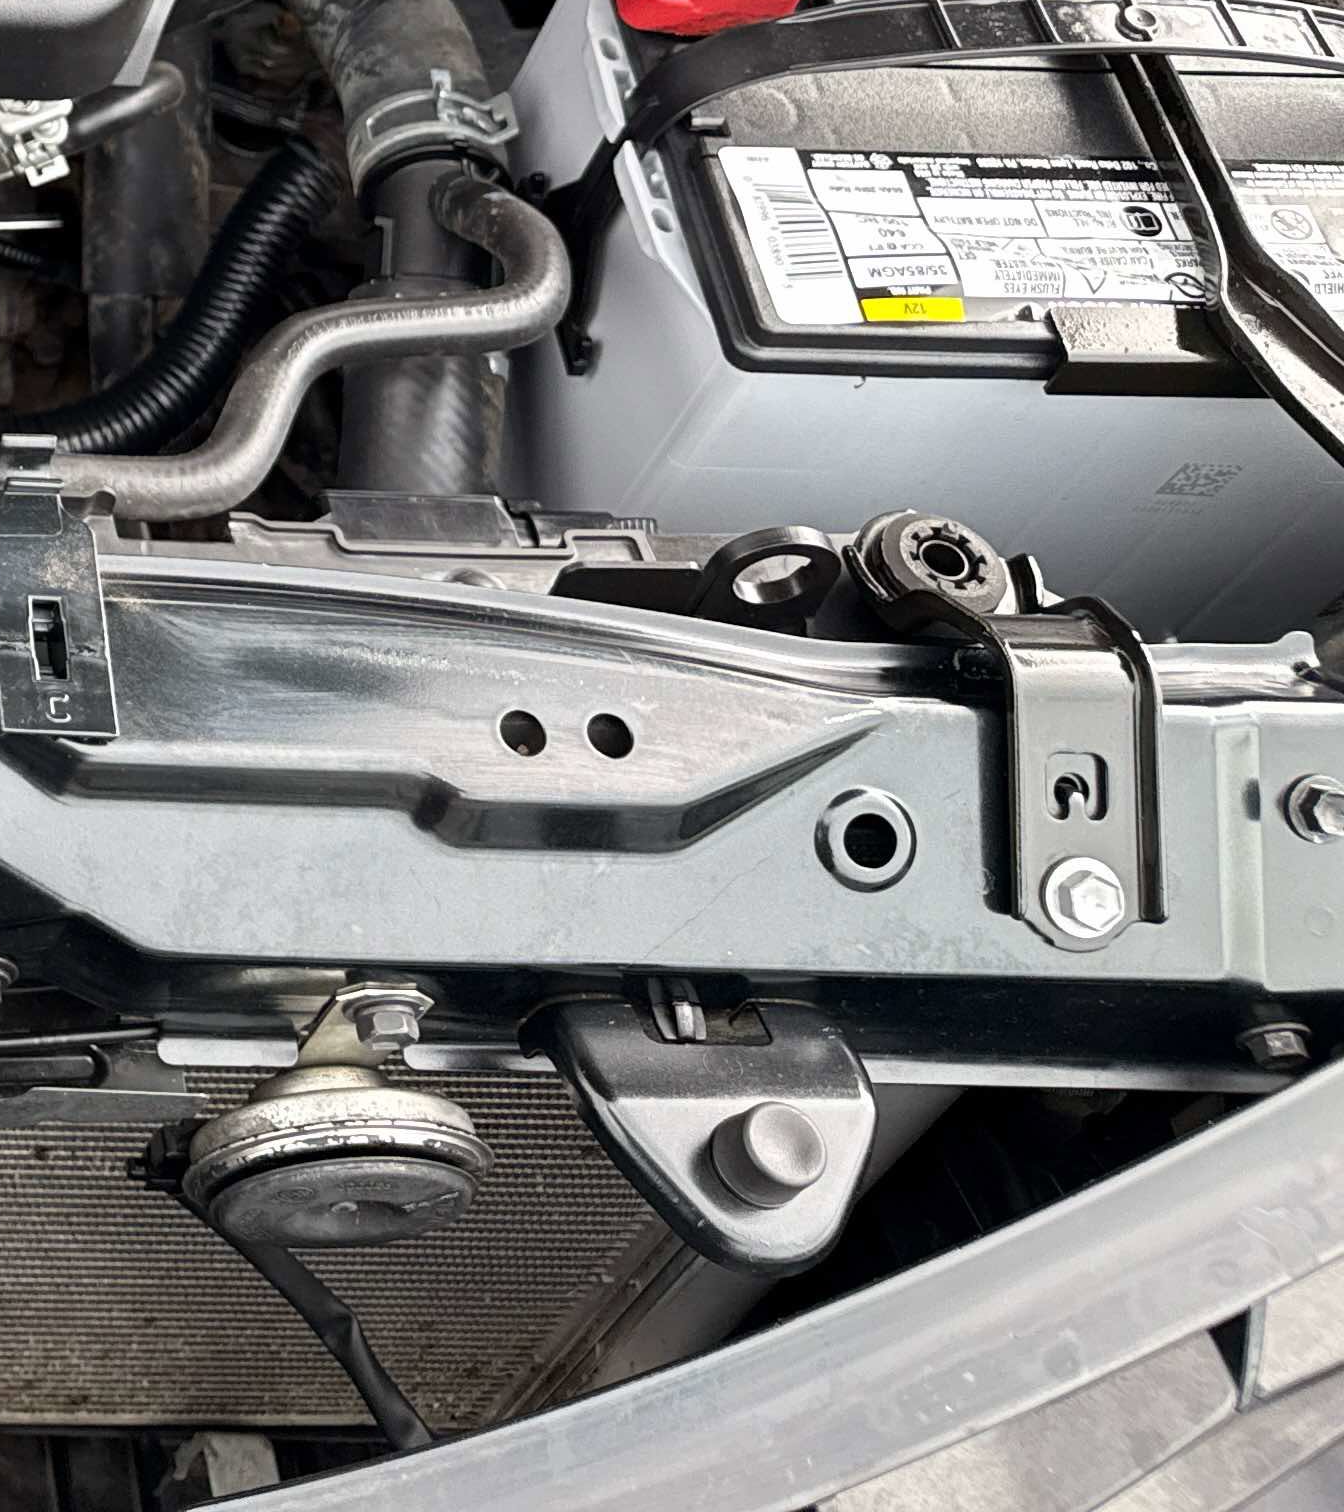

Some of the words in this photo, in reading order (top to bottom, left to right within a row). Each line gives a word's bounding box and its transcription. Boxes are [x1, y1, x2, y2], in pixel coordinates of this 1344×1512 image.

[1175, 257, 1199, 268] ARKS
[868, 264, 948, 278] 35/85AGM
[993, 269, 1061, 282] IMMEDIATELY
[1003, 282, 1028, 295] EYES
[1030, 282, 1060, 295] FLUSH
[1314, 283, 1344, 295] HIELD
[903, 303, 927, 314] 12V
